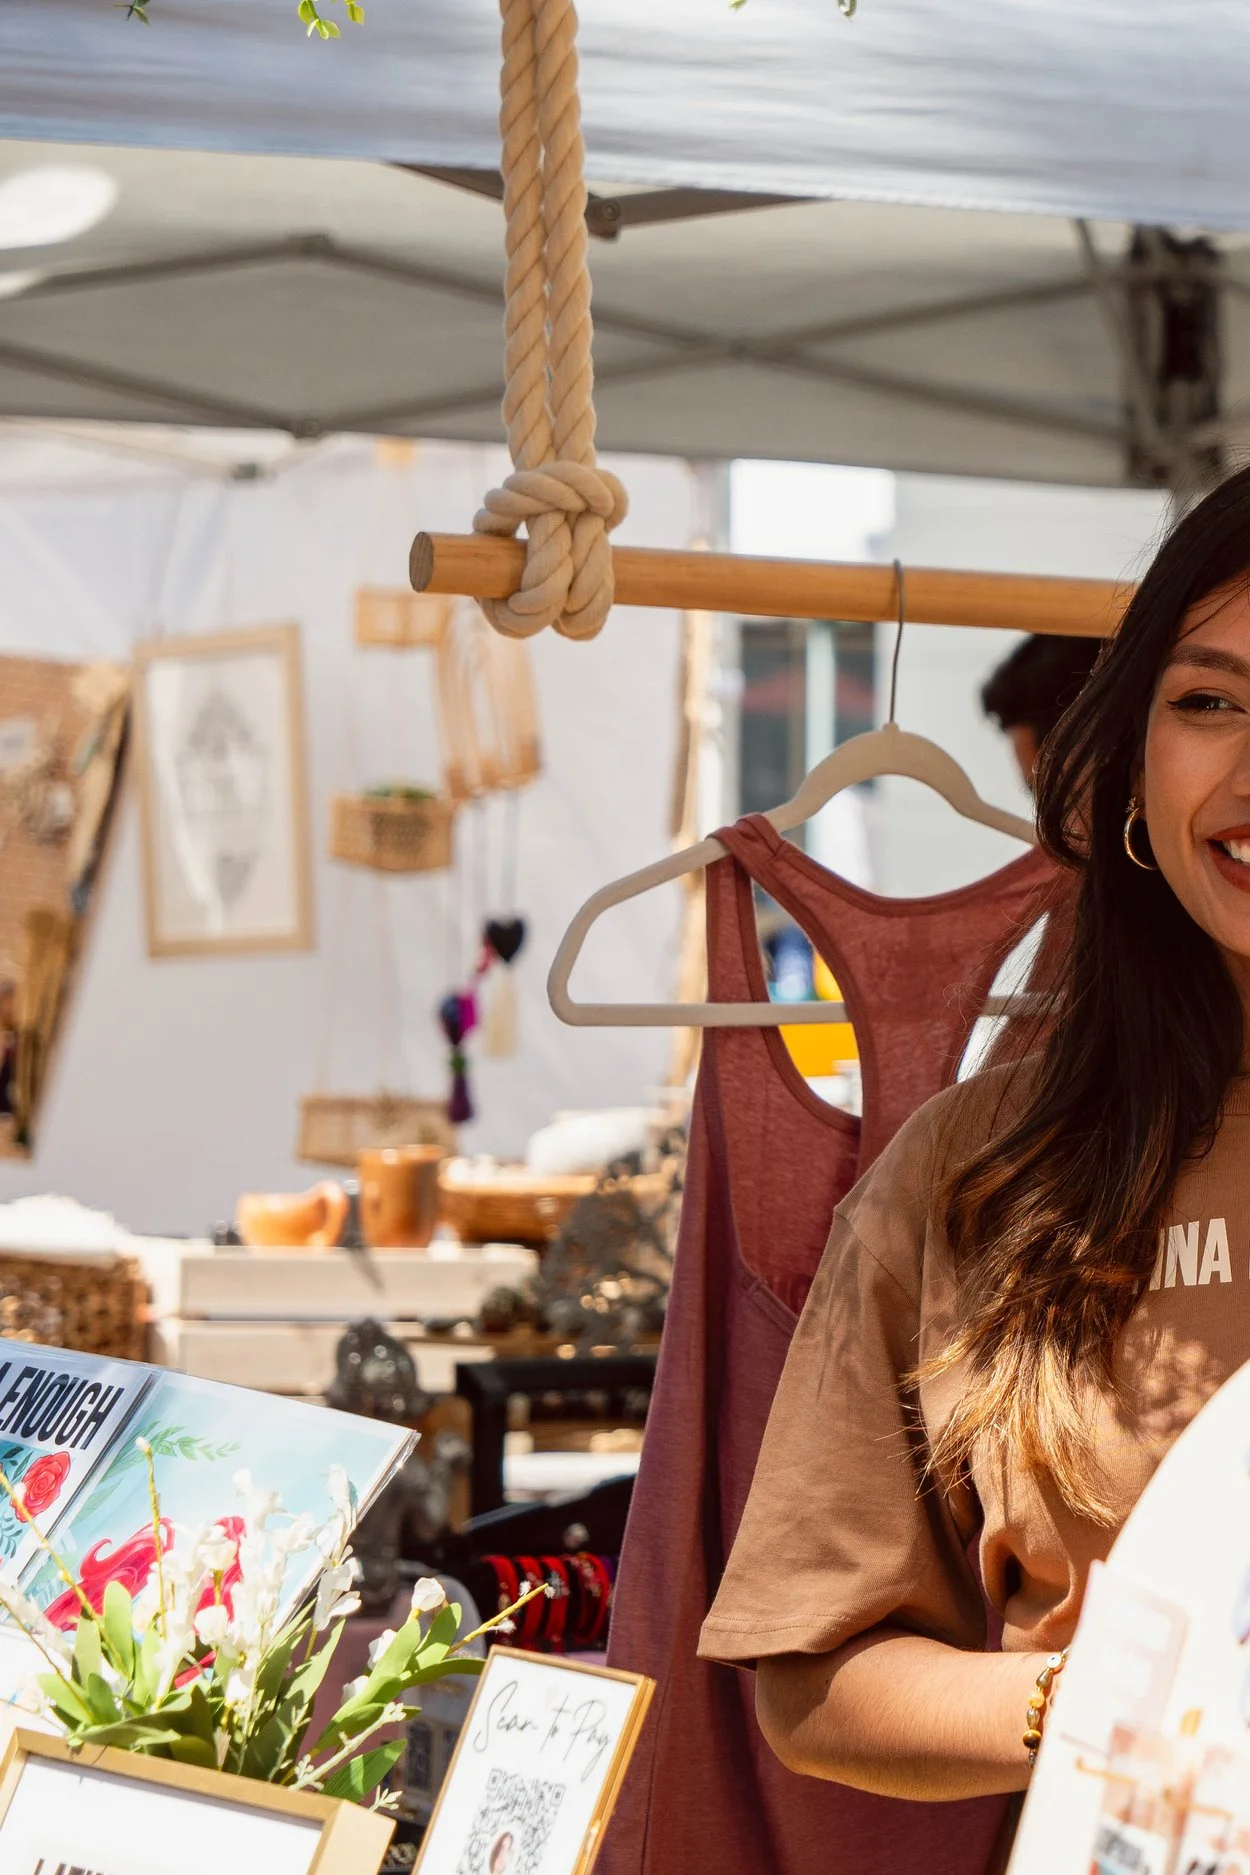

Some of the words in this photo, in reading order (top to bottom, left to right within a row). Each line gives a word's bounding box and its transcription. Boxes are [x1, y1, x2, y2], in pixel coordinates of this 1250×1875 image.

[1131, 1217, 1232, 1294] INA
[0, 1366, 125, 1450] ENOUGH
[473, 1680, 537, 1753] Scan
[539, 1693, 571, 1753] to
[563, 1699, 613, 1783] Pay
